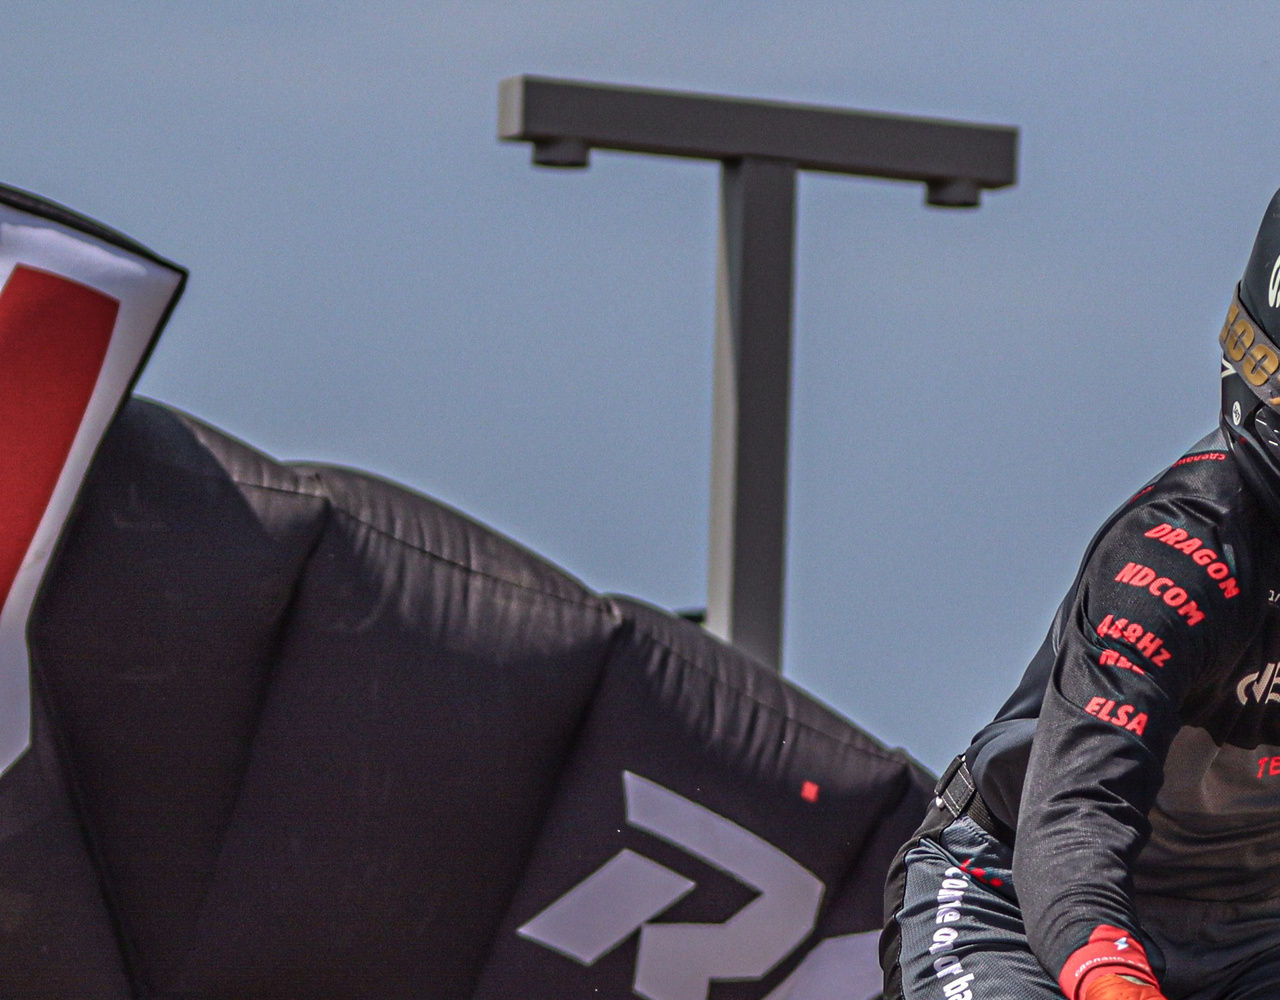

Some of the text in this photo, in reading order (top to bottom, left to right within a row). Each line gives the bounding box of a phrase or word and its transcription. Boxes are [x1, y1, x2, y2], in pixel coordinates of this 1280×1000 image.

[1144, 524, 1240, 598] DRAGON
[1115, 562, 1206, 627] NDCOM
[1085, 697, 1149, 736] ELSA
[936, 867, 970, 924] come
